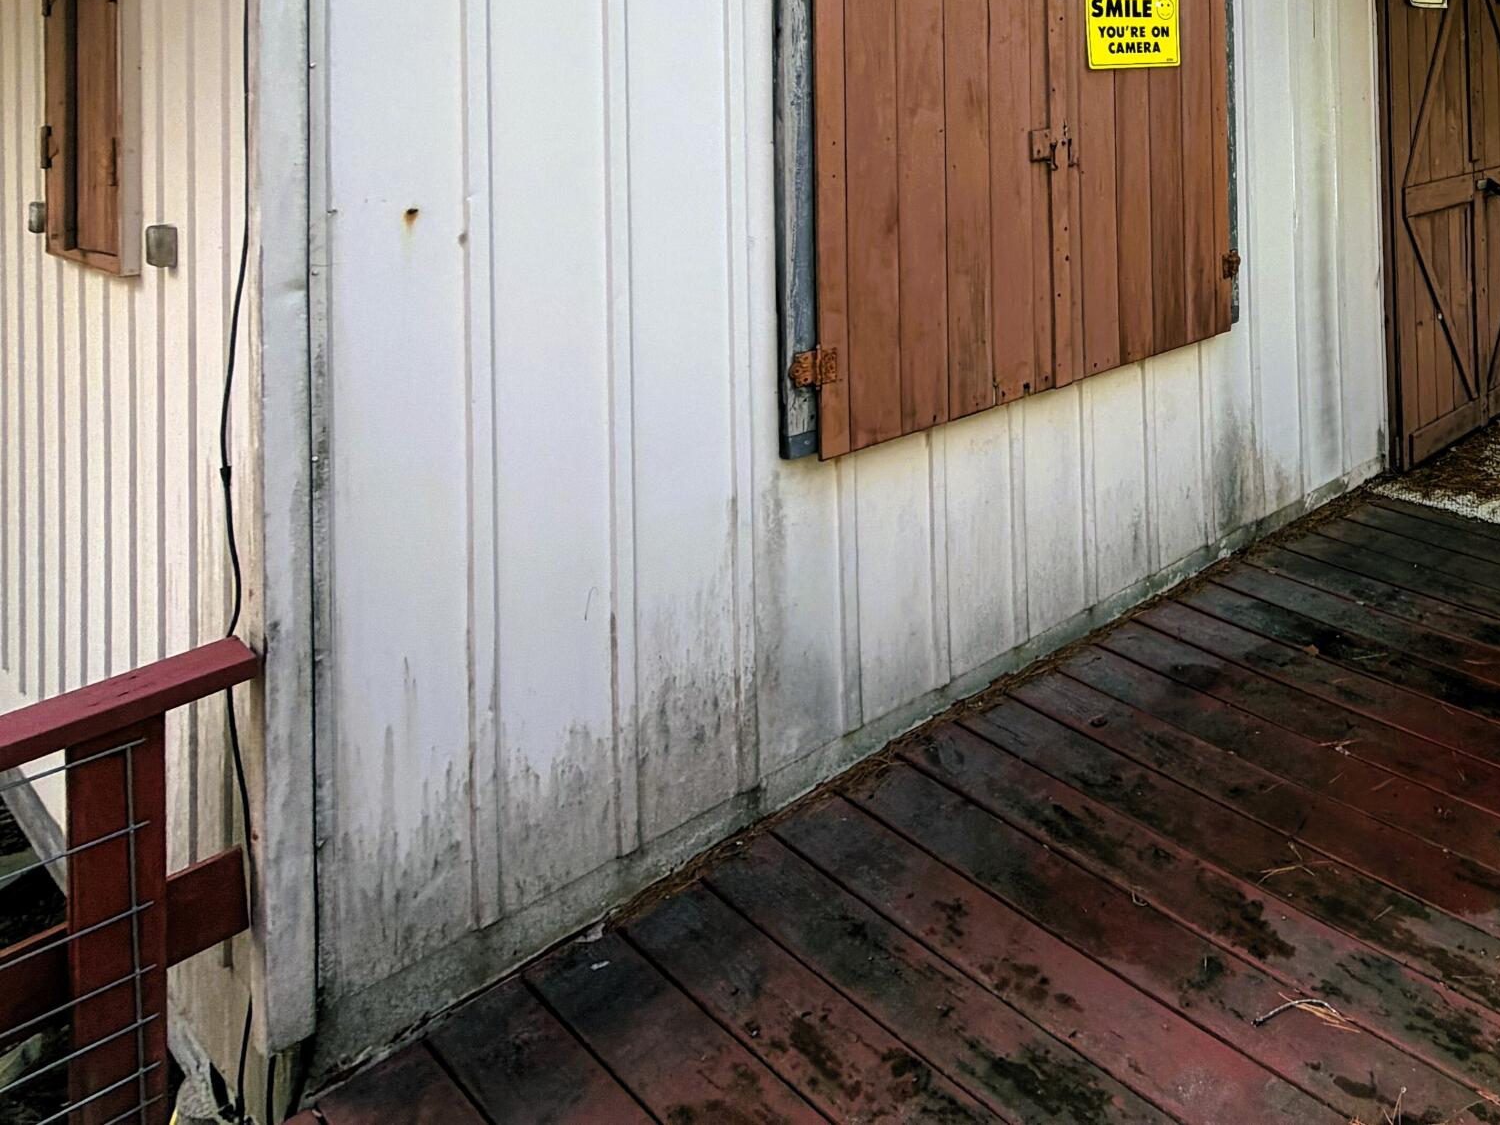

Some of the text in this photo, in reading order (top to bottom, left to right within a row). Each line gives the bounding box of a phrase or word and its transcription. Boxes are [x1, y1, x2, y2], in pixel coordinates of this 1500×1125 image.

[1098, 26, 1169, 38] YOU'RE ON
[1108, 42, 1161, 54] CAMERA
